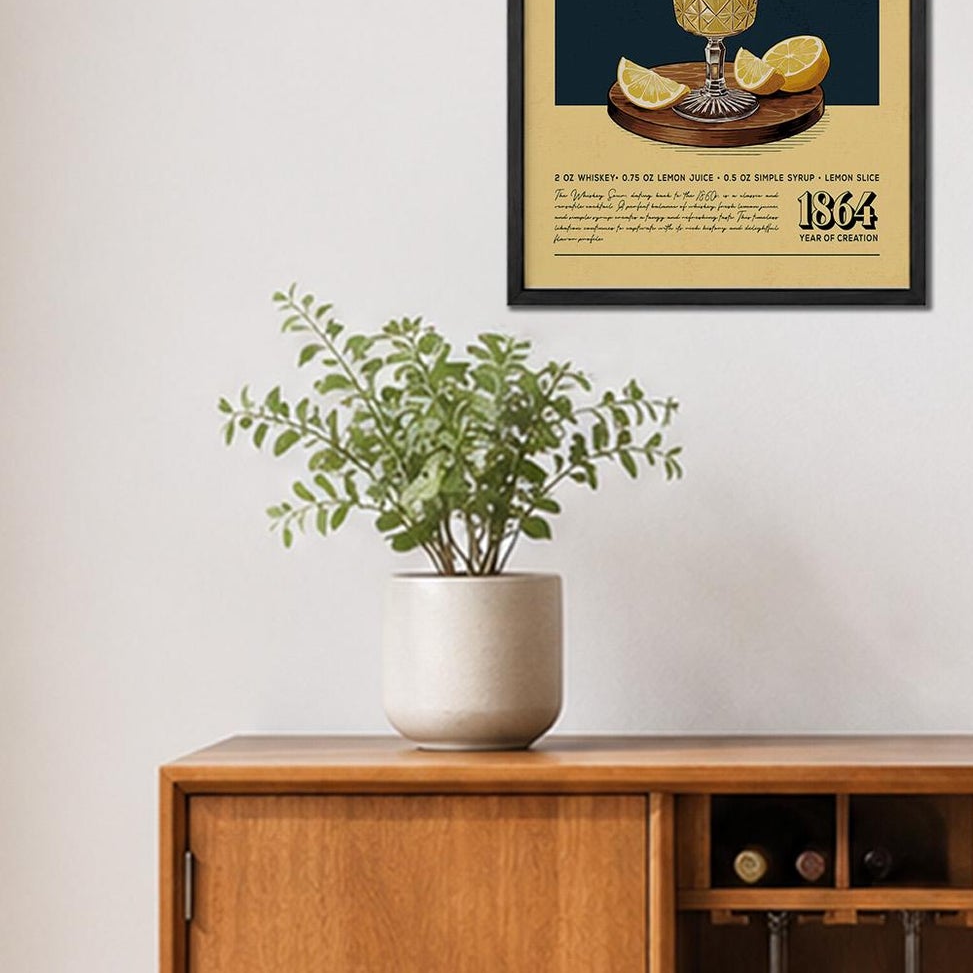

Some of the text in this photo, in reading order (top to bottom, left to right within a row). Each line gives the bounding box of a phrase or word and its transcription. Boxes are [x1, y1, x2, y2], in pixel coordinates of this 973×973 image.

[554, 173, 561, 182] 2
[562, 173, 575, 182] OZ
[621, 173, 640, 182] 0.75
[642, 173, 655, 182] OZ
[657, 173, 686, 182] LEMON
[688, 173, 714, 182] JUICE
[723, 173, 737, 182] 0.5
[739, 173, 752, 182] OZ
[754, 173, 784, 182] SIMPLE
[787, 173, 815, 182] SYRUP
[824, 173, 854, 182] LEMON
[856, 173, 880, 182] SLICE
[797, 190, 879, 230] 1864
[799, 233, 879, 243] YEAR OF CREATION
